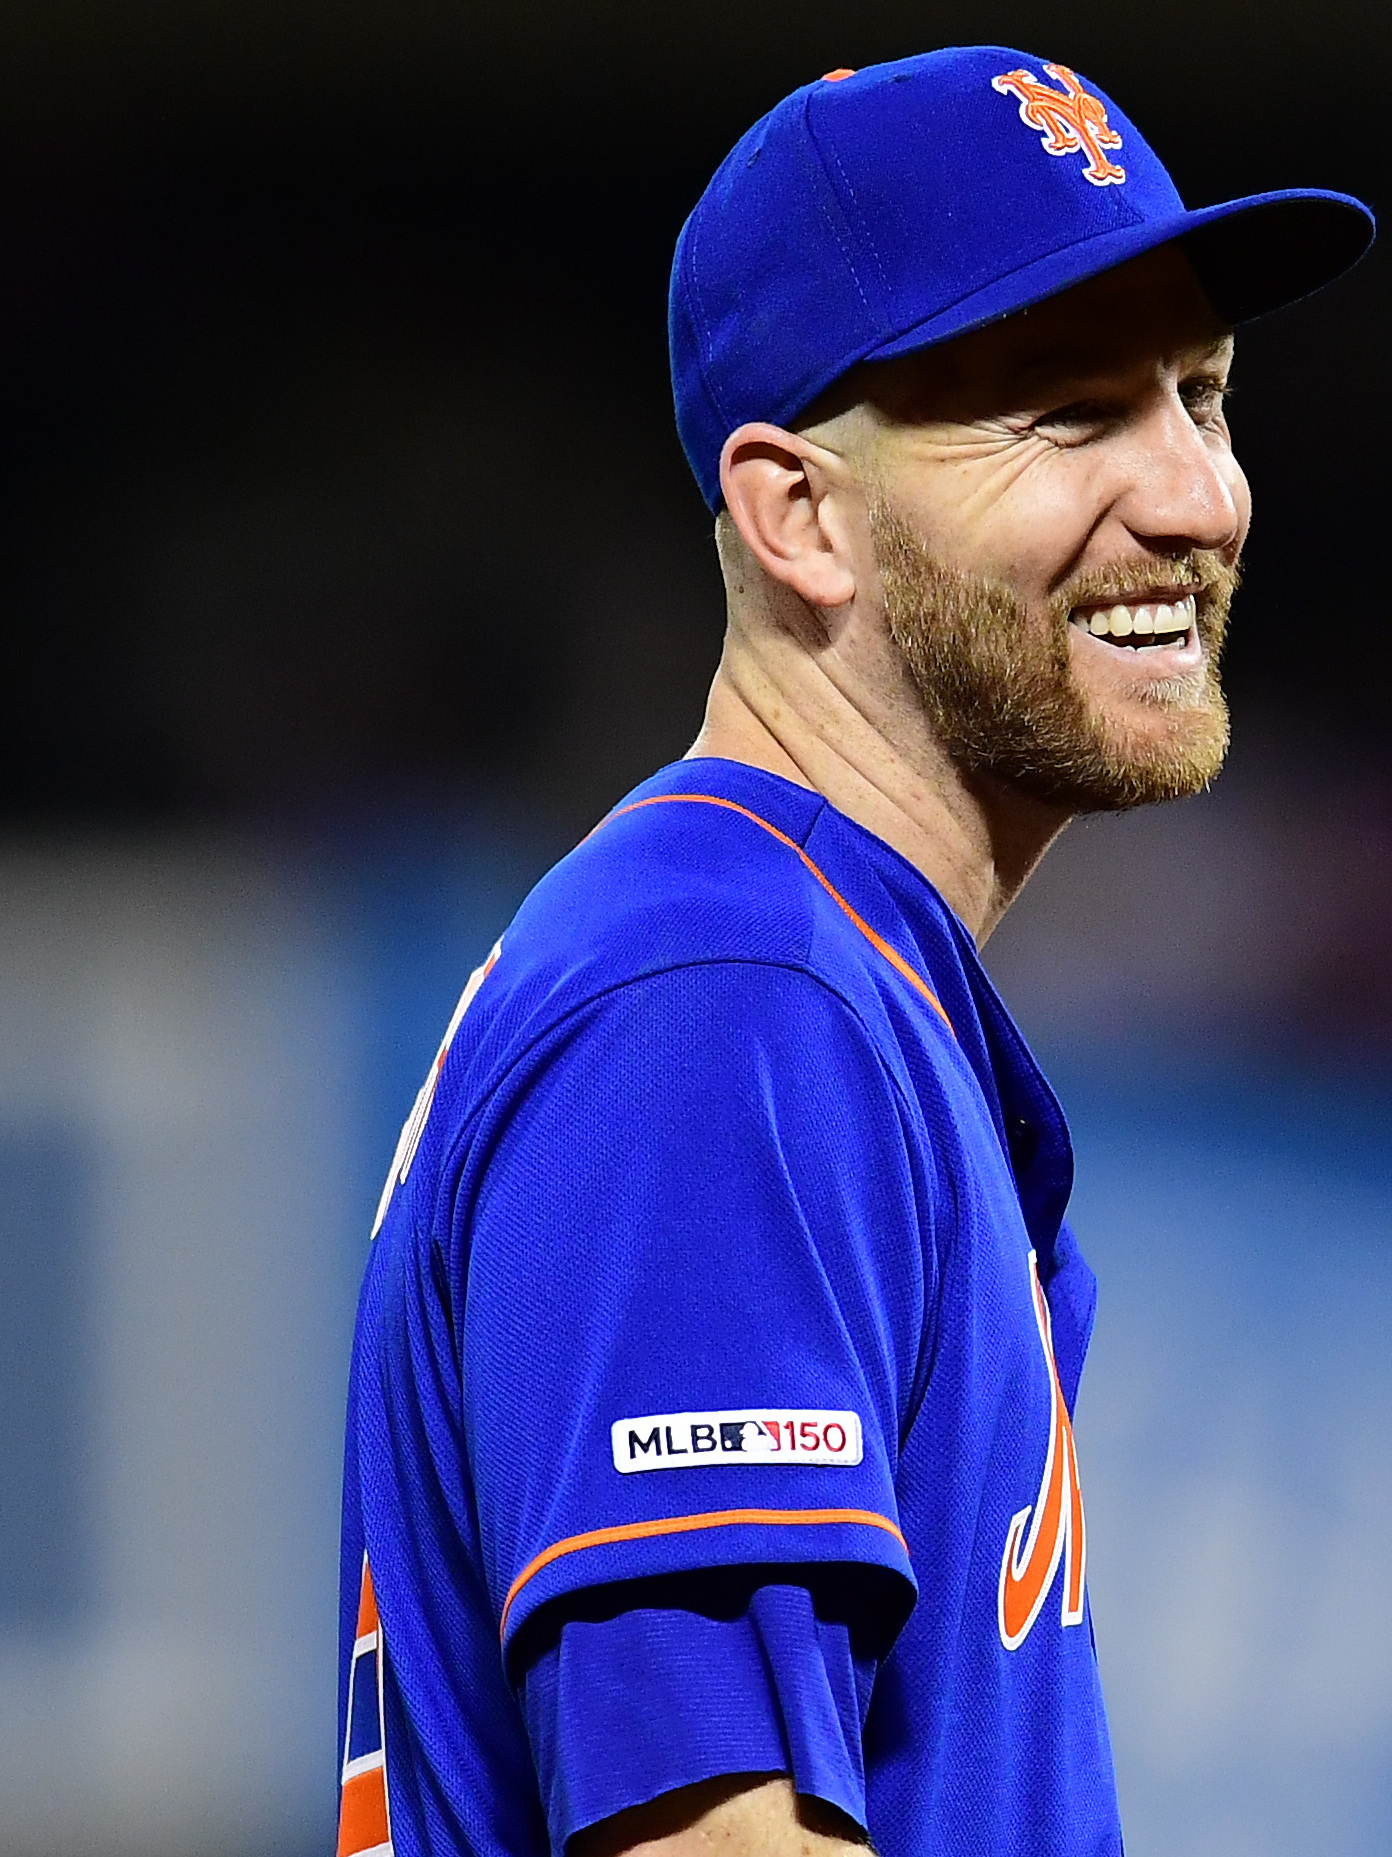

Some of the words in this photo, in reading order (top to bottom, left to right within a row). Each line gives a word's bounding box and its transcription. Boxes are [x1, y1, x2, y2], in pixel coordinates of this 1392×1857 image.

[991, 62, 1126, 186] NY
[628, 1423, 717, 1460] MLB
[783, 1420, 847, 1453] 150
